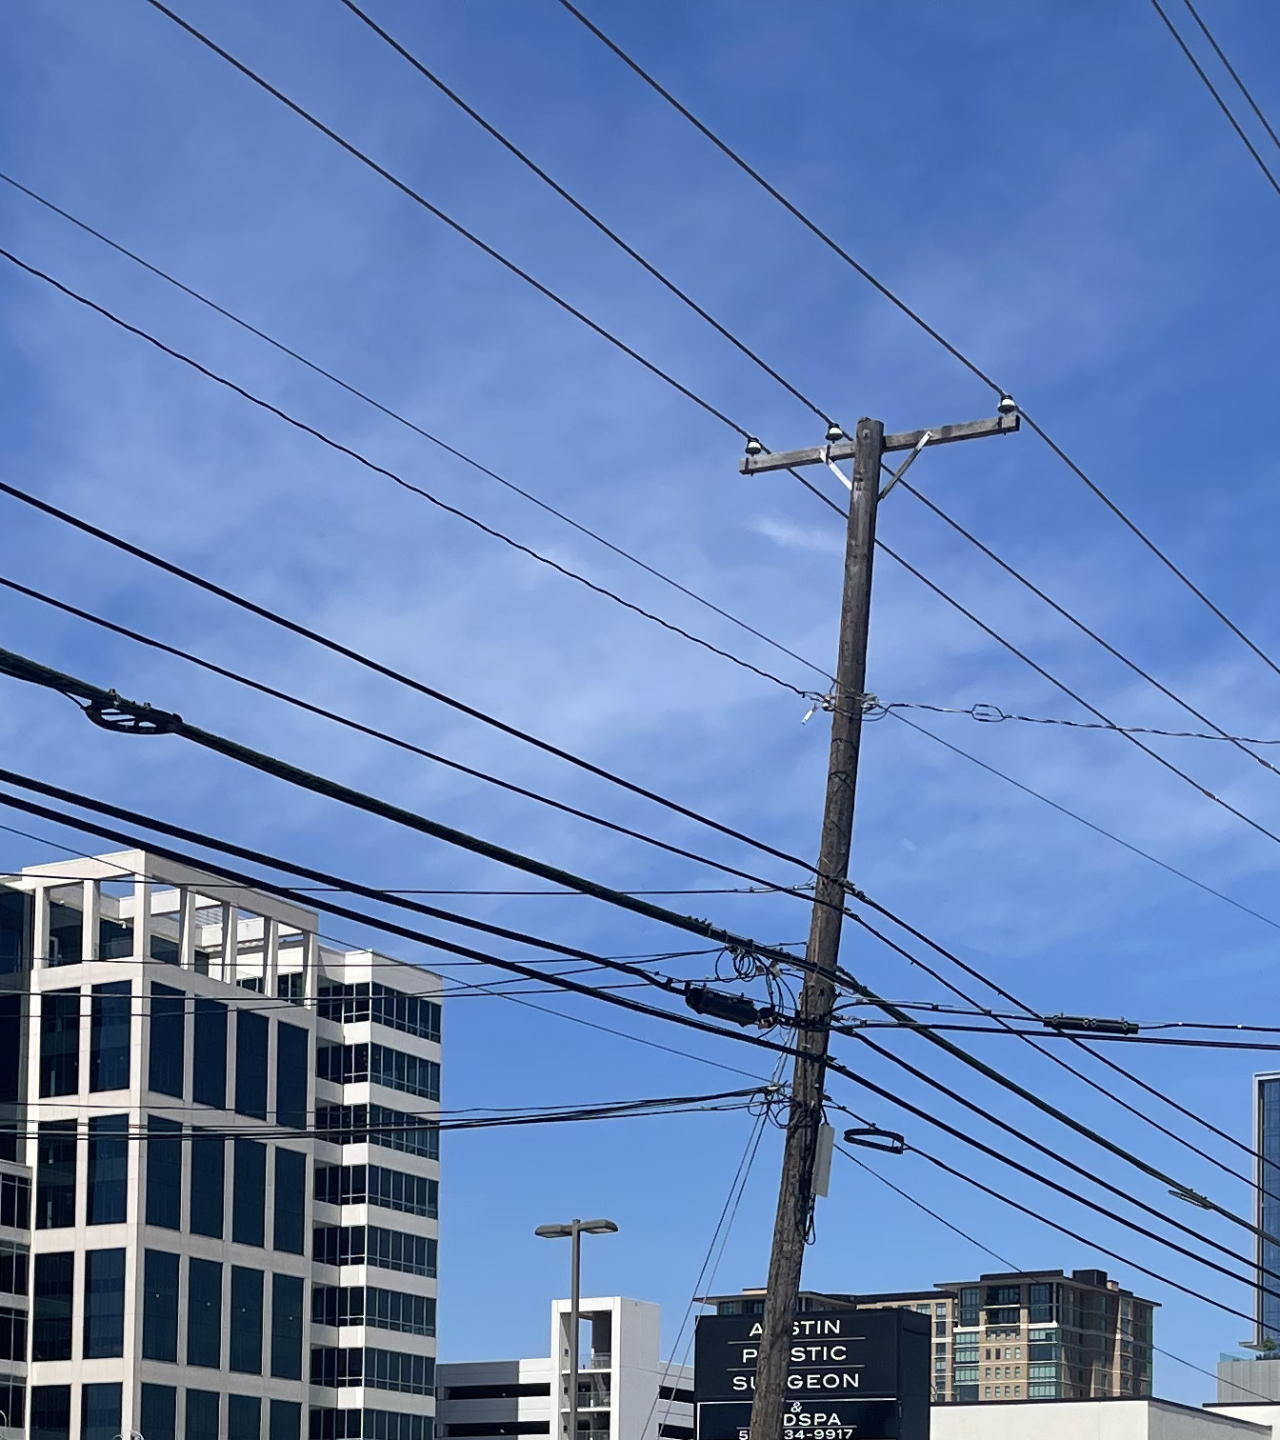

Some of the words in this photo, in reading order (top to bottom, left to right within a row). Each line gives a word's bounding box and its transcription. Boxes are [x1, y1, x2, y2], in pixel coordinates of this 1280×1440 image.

[748, 1319, 841, 1338] ASTIN
[742, 1346, 847, 1363] PSTIC
[790, 1401, 803, 1413] &
[783, 1413, 842, 1426] DSPA
